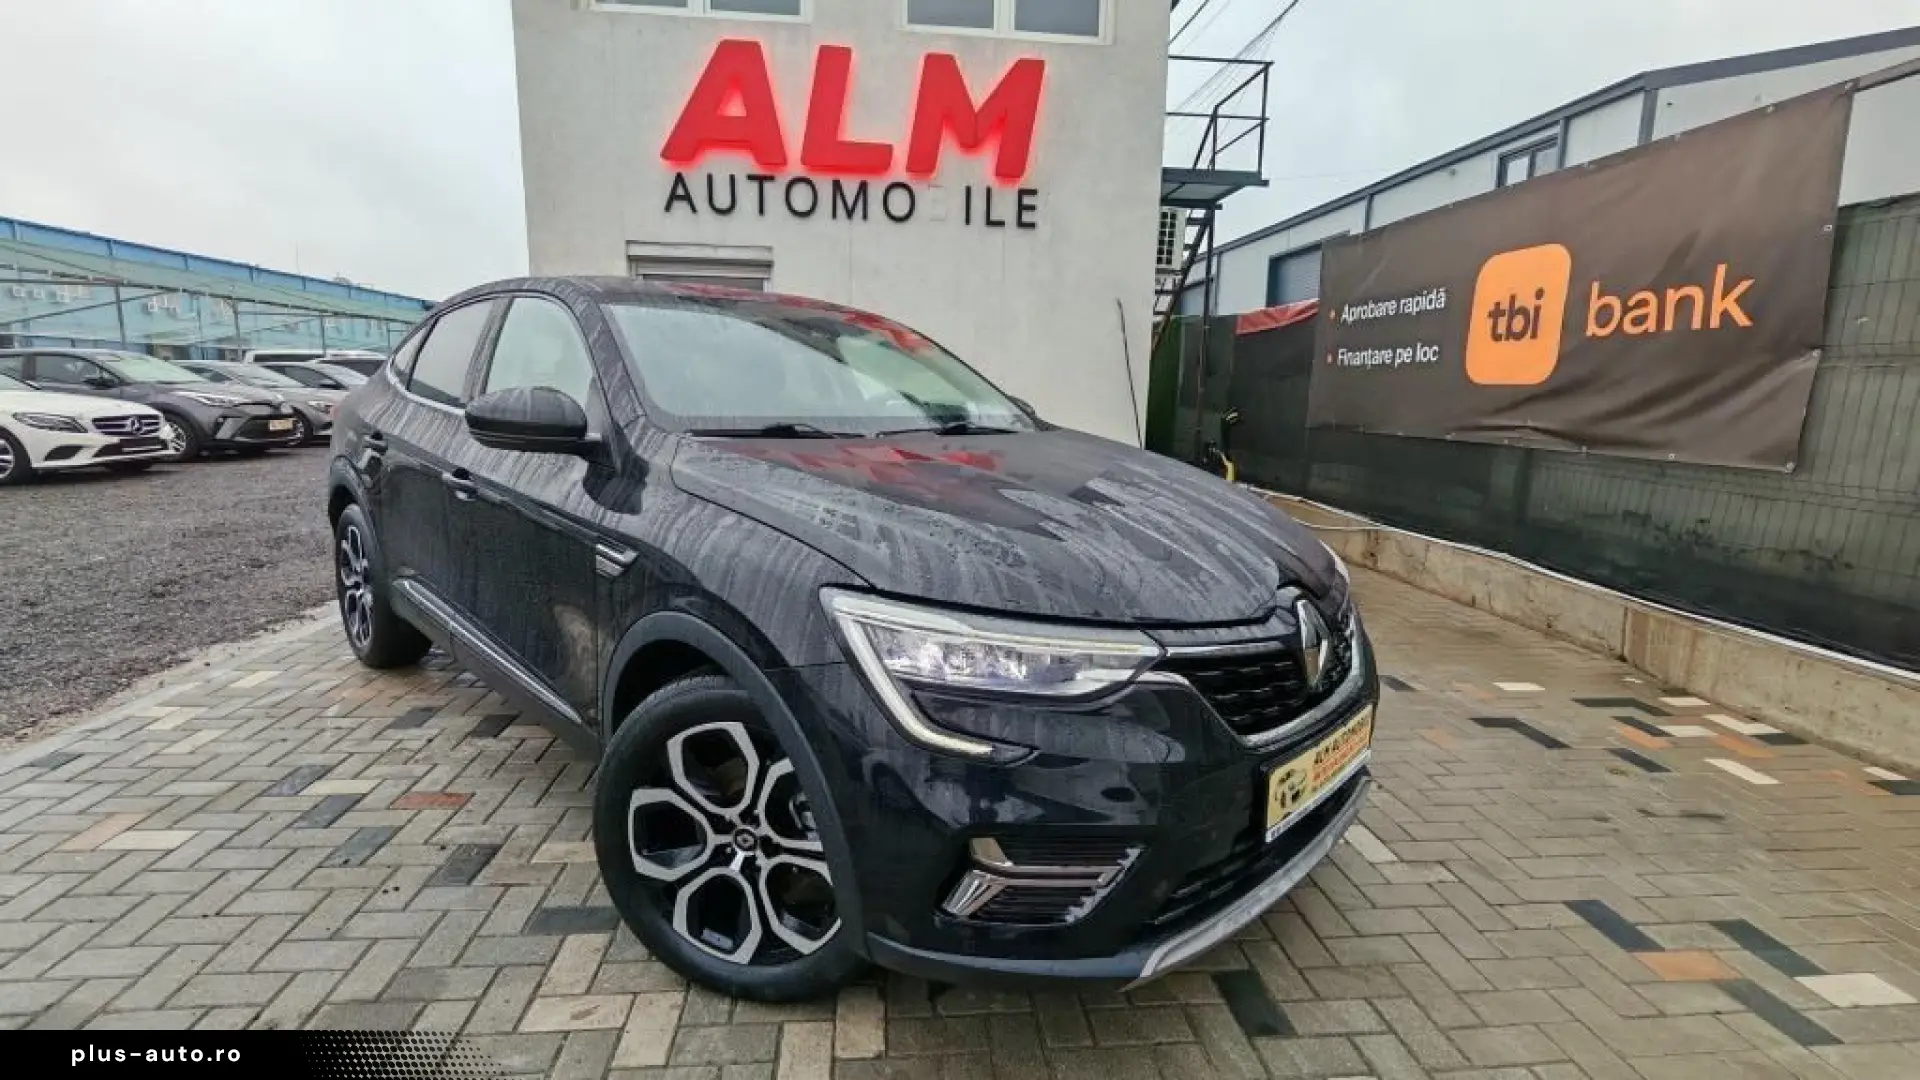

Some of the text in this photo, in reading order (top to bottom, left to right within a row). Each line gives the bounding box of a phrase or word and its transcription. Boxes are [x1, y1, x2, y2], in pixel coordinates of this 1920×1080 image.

[660, 38, 1046, 179] ALM
[664, 171, 1039, 229] AUTOMOILE
[1340, 287, 1447, 325] Aprobare rapidă
[1486, 263, 1756, 342] tbi bank
[1395, 346, 1413, 368] pe
[1415, 342, 1440, 363] loc
